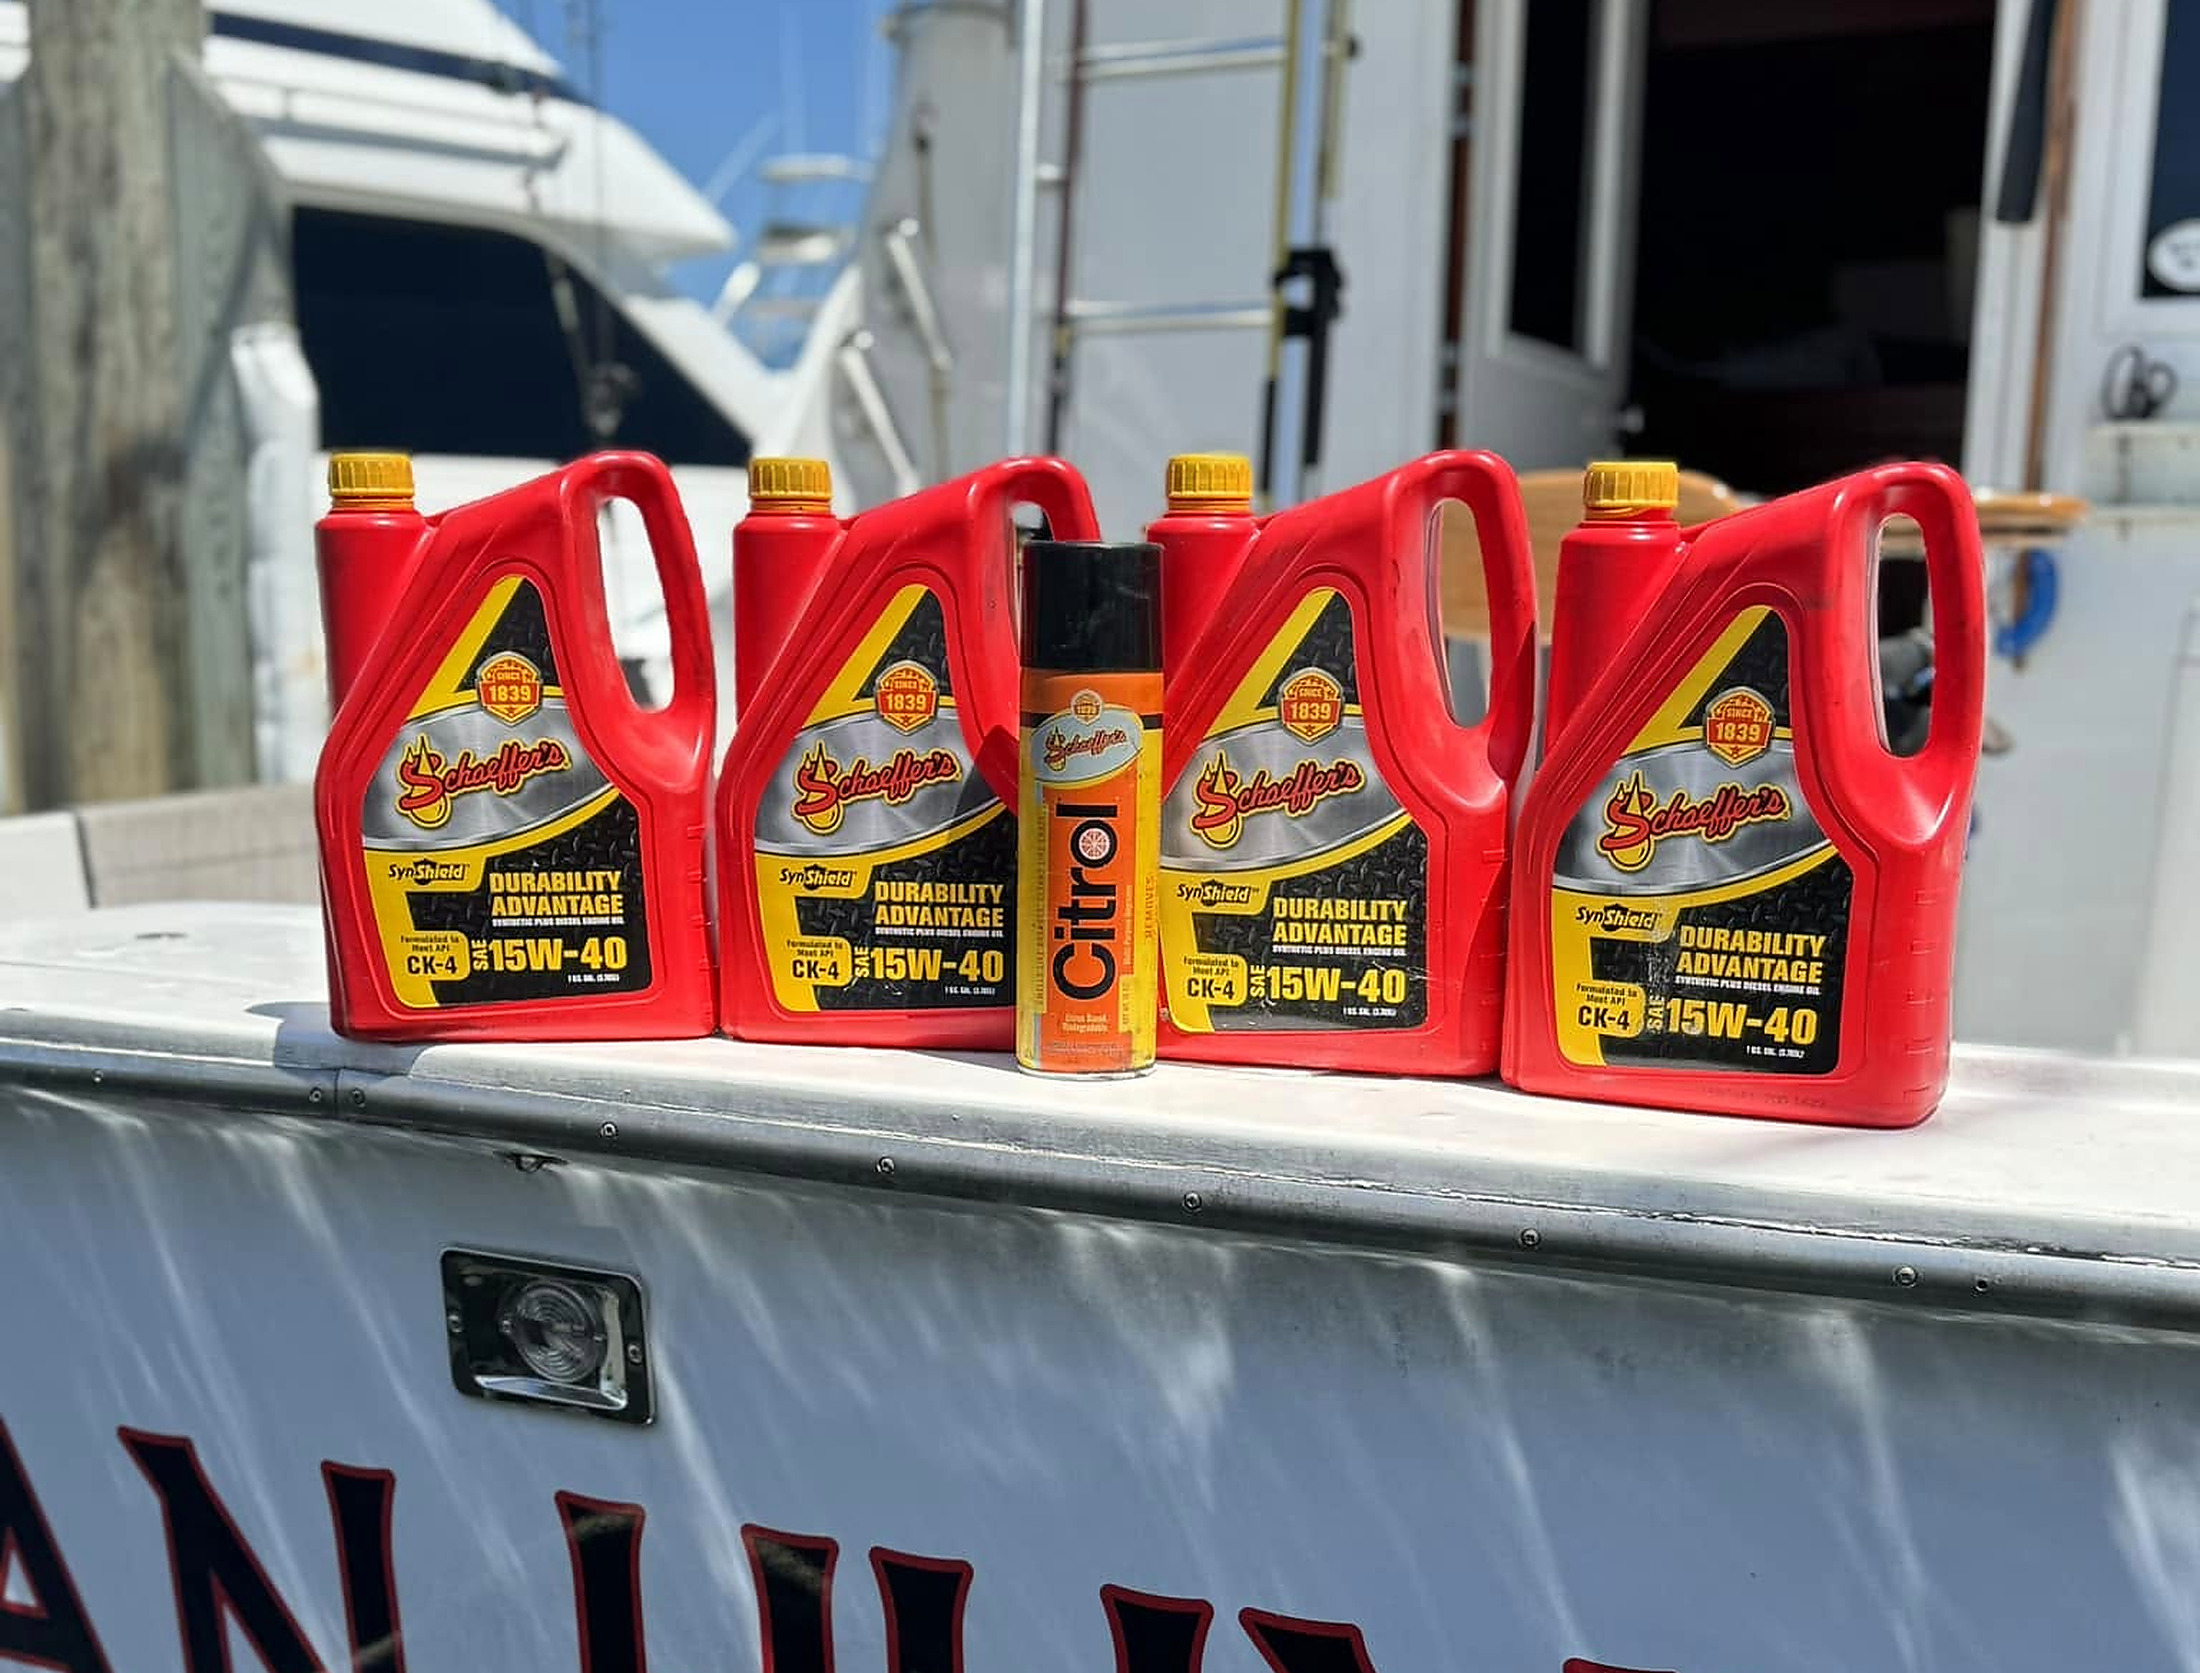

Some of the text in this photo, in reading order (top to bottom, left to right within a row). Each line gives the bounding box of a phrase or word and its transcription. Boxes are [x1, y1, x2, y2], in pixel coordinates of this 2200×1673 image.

[489, 685, 531, 702] 1839
[886, 693, 926, 712] 1839
[1289, 702, 1331, 720] 1839
[1716, 722, 1761, 742] 1839
[398, 739, 568, 812] Schaeffer's
[793, 749, 959, 818] Schaeffer's
[1191, 760, 1364, 831] Schaeffer's
[1599, 784, 1787, 852] Schaeffer's
[389, 860, 464, 884] SynShield
[488, 871, 621, 894] DURABILITY
[779, 867, 851, 889] SynShield
[874, 881, 1003, 904] DURABILITY
[1052, 804, 1118, 1000] Citrol
[1176, 882, 1251, 905] SynShield
[491, 894, 624, 916] ADVANTAGE
[874, 905, 1004, 928] ADVANTAGE
[1273, 897, 1407, 920] DURABILITY
[1575, 906, 1656, 931] SynShield
[1272, 922, 1407, 946] ADVANTAGE
[1679, 925, 1827, 958] DURABILITY
[407, 955, 458, 975] CK-4
[472, 936, 628, 972] SAE 15W-40
[854, 945, 1004, 982] SAE 15W-40
[1183, 957, 1229, 967] Formulated
[792, 960, 839, 980] CK-4
[1675, 951, 1823, 984] ADVANTAGE
[1187, 978, 1235, 999] CK-4
[1250, 965, 1407, 1004] SAE 15W-40
[1575, 983, 1628, 996] Formulated
[1577, 1006, 1631, 1030] CK-4
[1647, 995, 1818, 1045] SAE 15W-40
